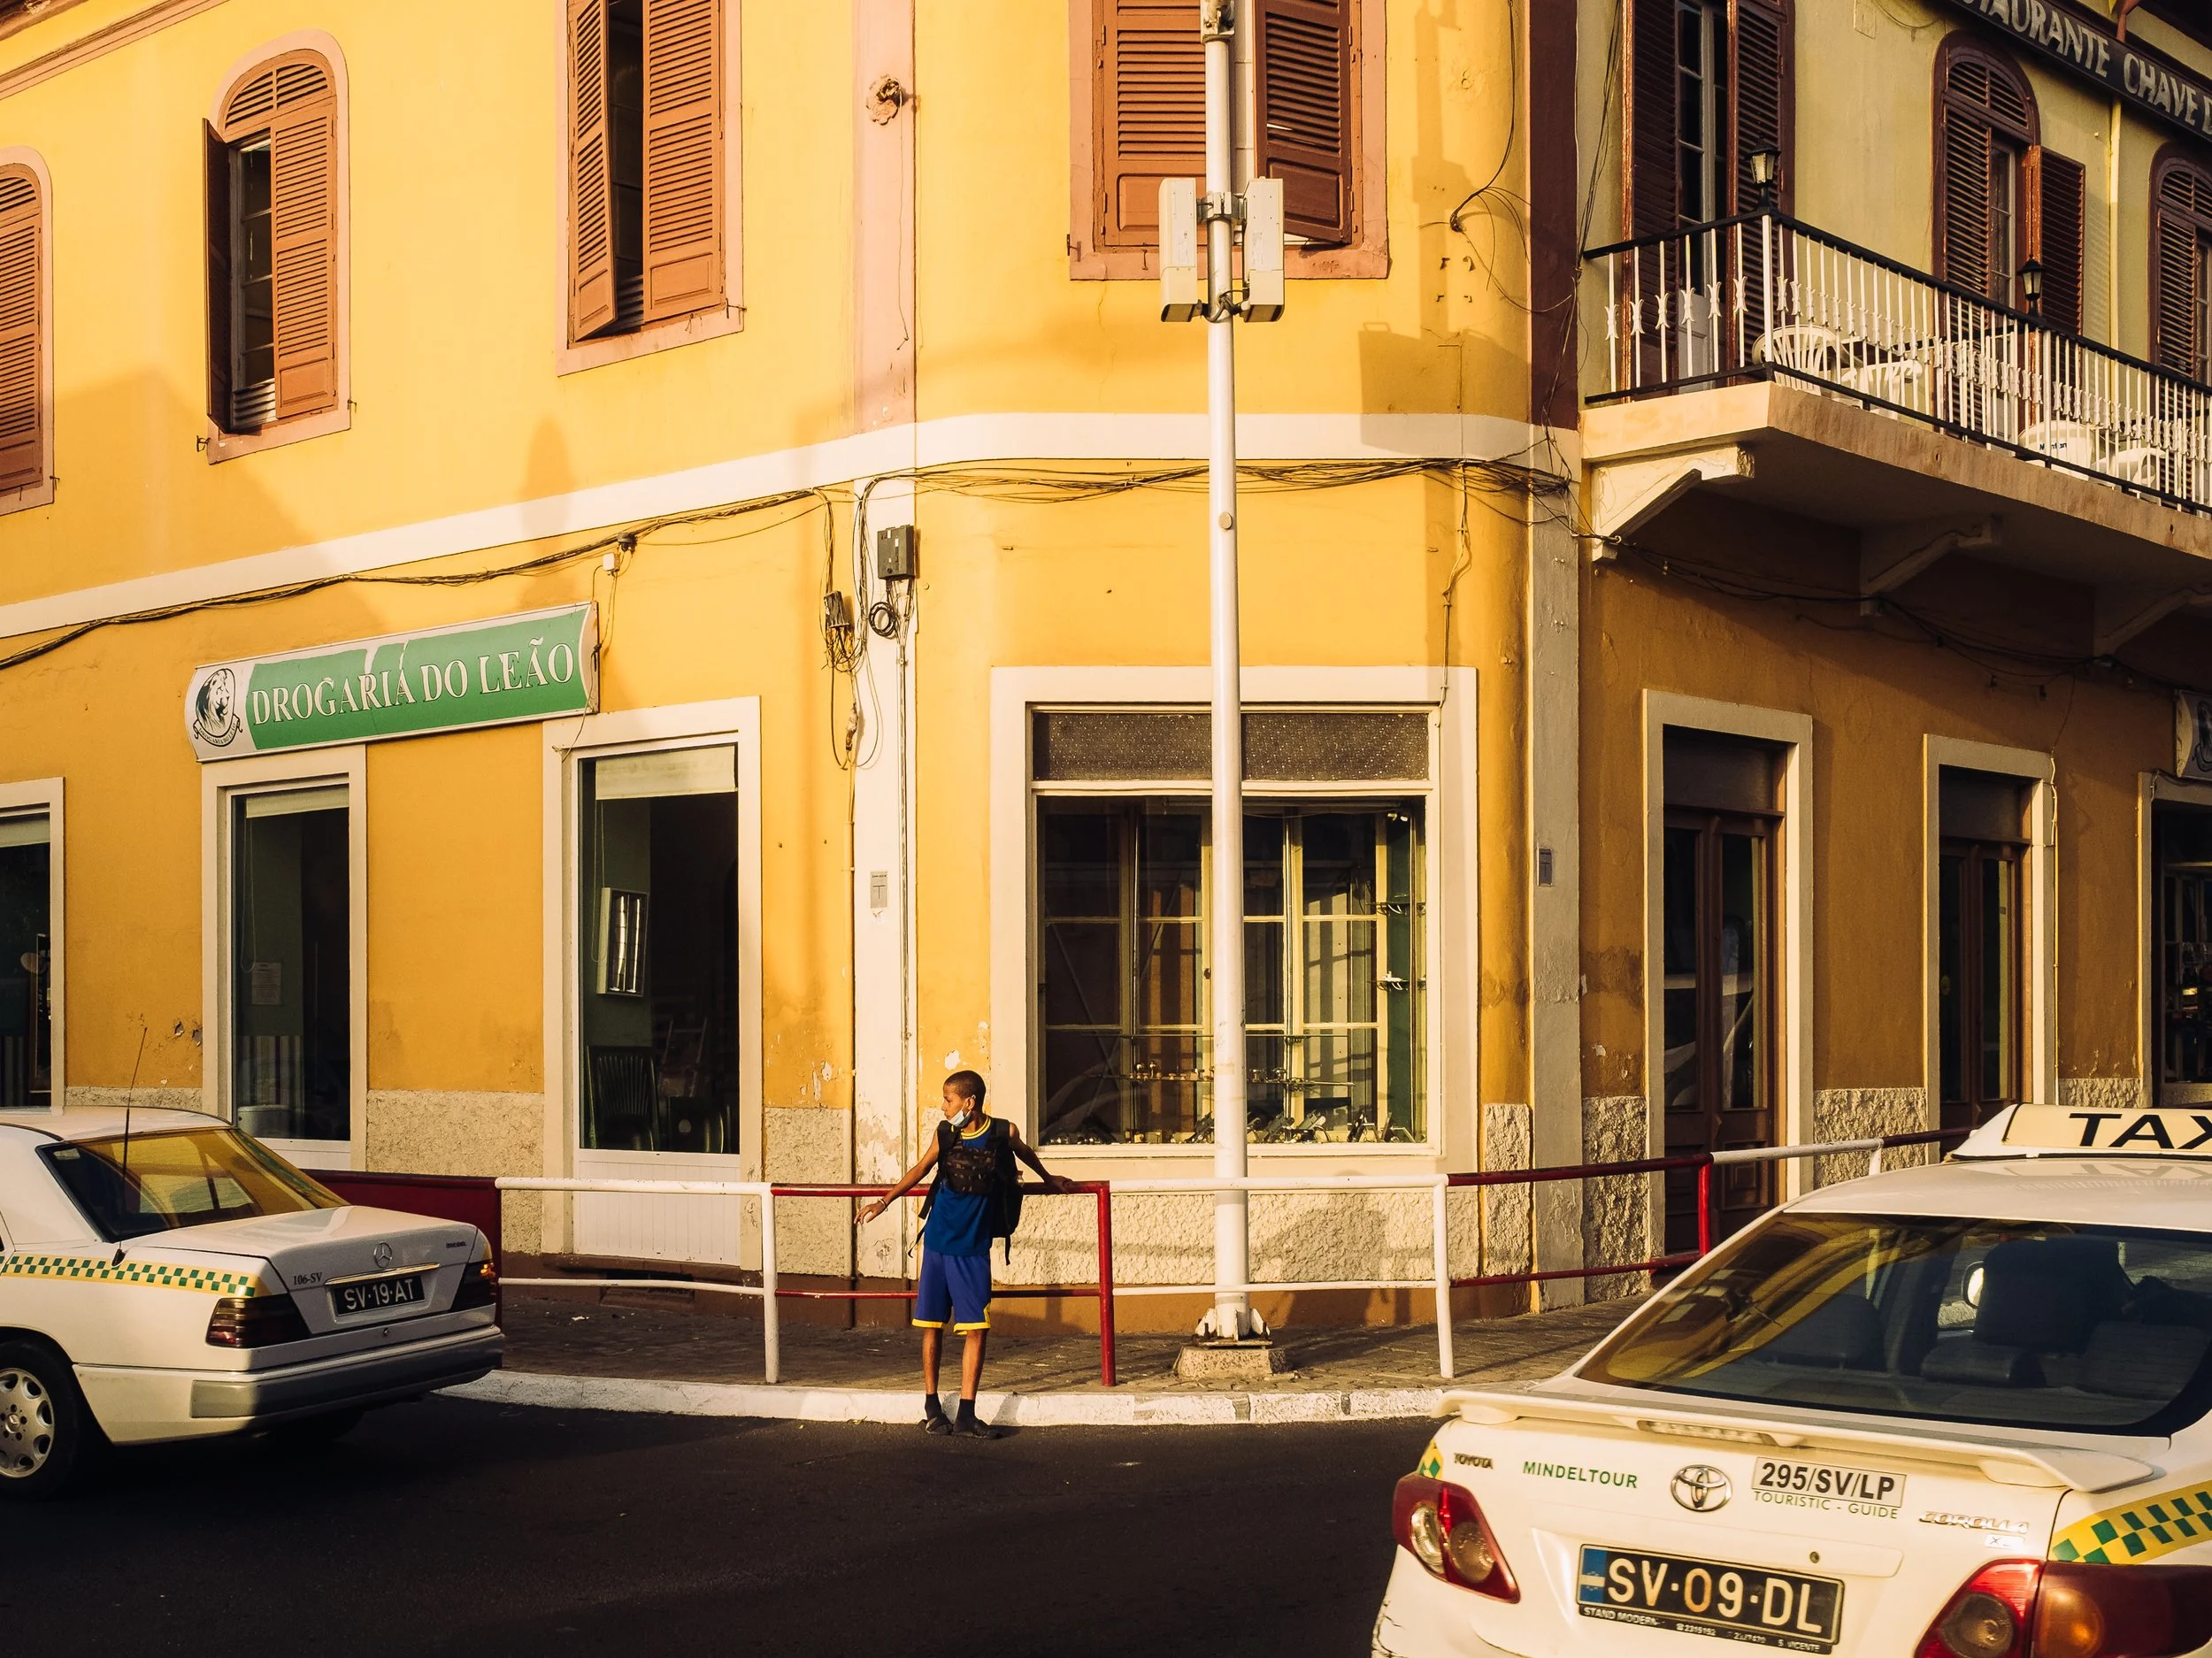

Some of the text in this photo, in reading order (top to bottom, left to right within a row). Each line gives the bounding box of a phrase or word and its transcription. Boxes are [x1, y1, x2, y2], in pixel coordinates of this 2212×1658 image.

[2124, 52, 2199, 126] CHAVE
[251, 635, 575, 726] DROGARIA DO LEÃO
[293, 1271, 323, 1286] 106-SV
[1453, 1453, 1494, 1470] TOYOTA
[1523, 1461, 1638, 1489] MINDELTOUR
[1759, 1462, 1895, 1501] 295/SV/LP
[1754, 1491, 1832, 1510] TOURISTIC
[1847, 1503, 1898, 1519] GUIDE
[1584, 1607, 1616, 1620] STAND
